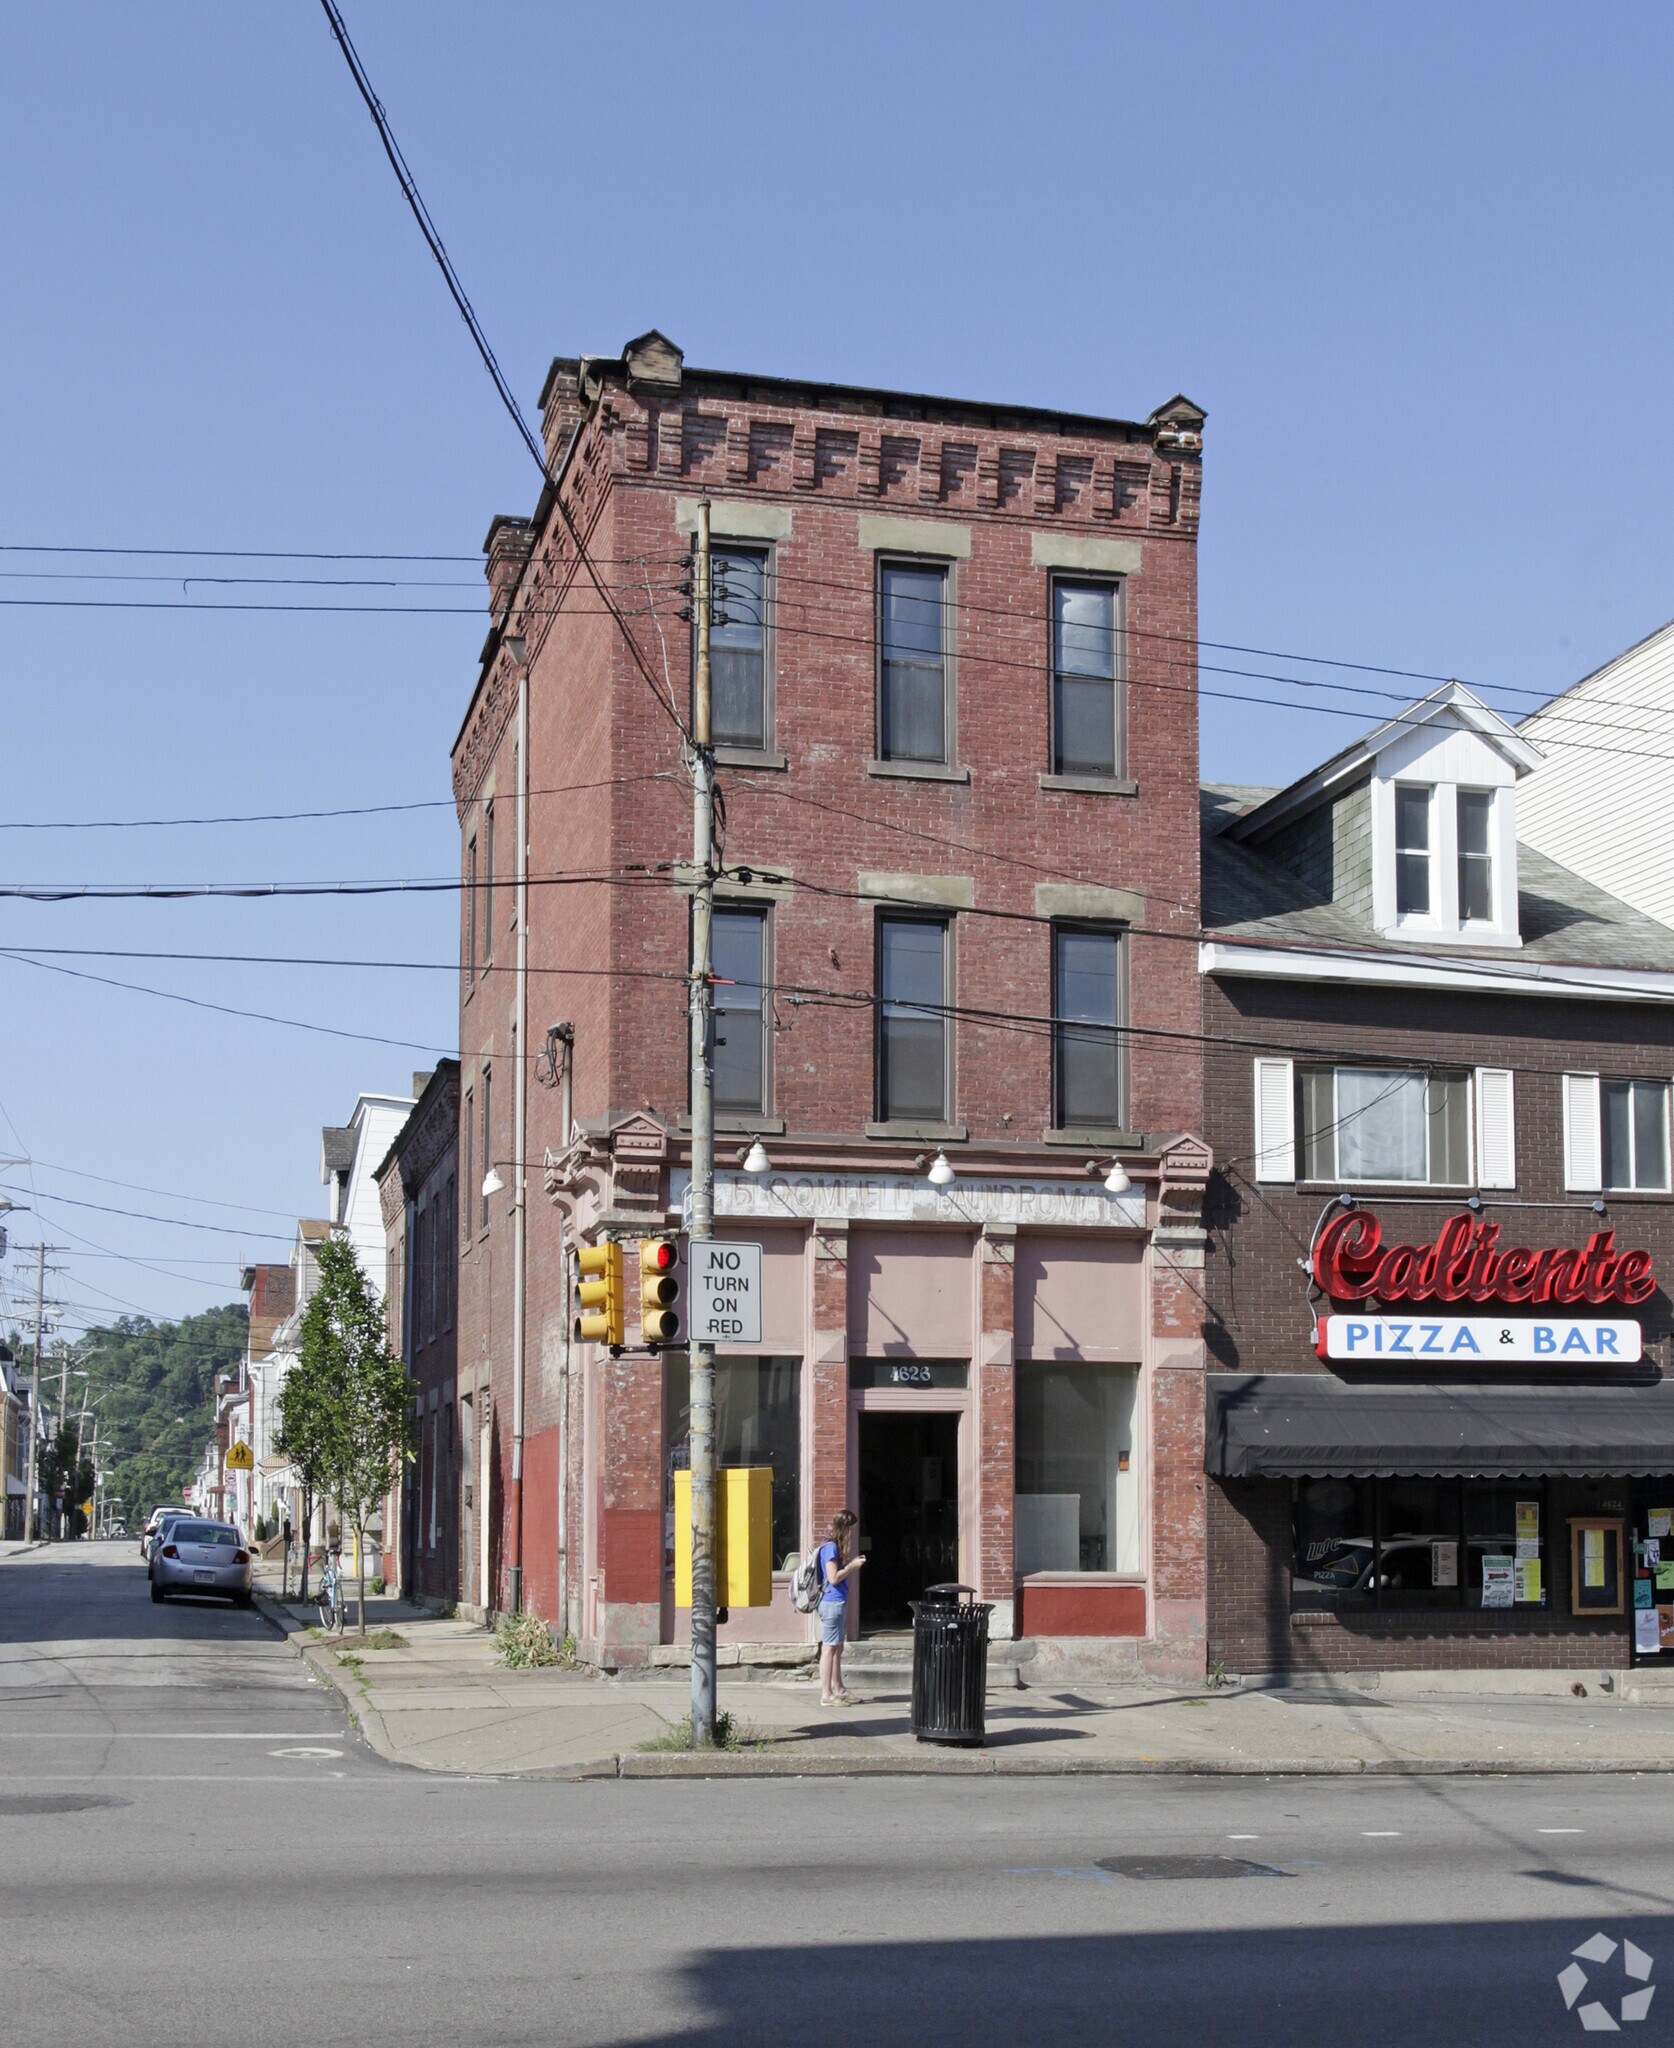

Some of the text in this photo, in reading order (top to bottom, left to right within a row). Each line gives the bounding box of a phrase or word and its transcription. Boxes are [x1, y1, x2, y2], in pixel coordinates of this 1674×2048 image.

[730, 1176, 1113, 1220] BLOOMFIELD LAUNDROMAT
[710, 1251, 741, 1270] NO
[1313, 1211, 1657, 1304] Caliente
[702, 1276, 749, 1292] TURN
[712, 1297, 738, 1313] ON
[708, 1318, 743, 1334] RED
[1346, 1323, 1621, 1355] PIZZA & BAR
[889, 1365, 931, 1382] 4626
